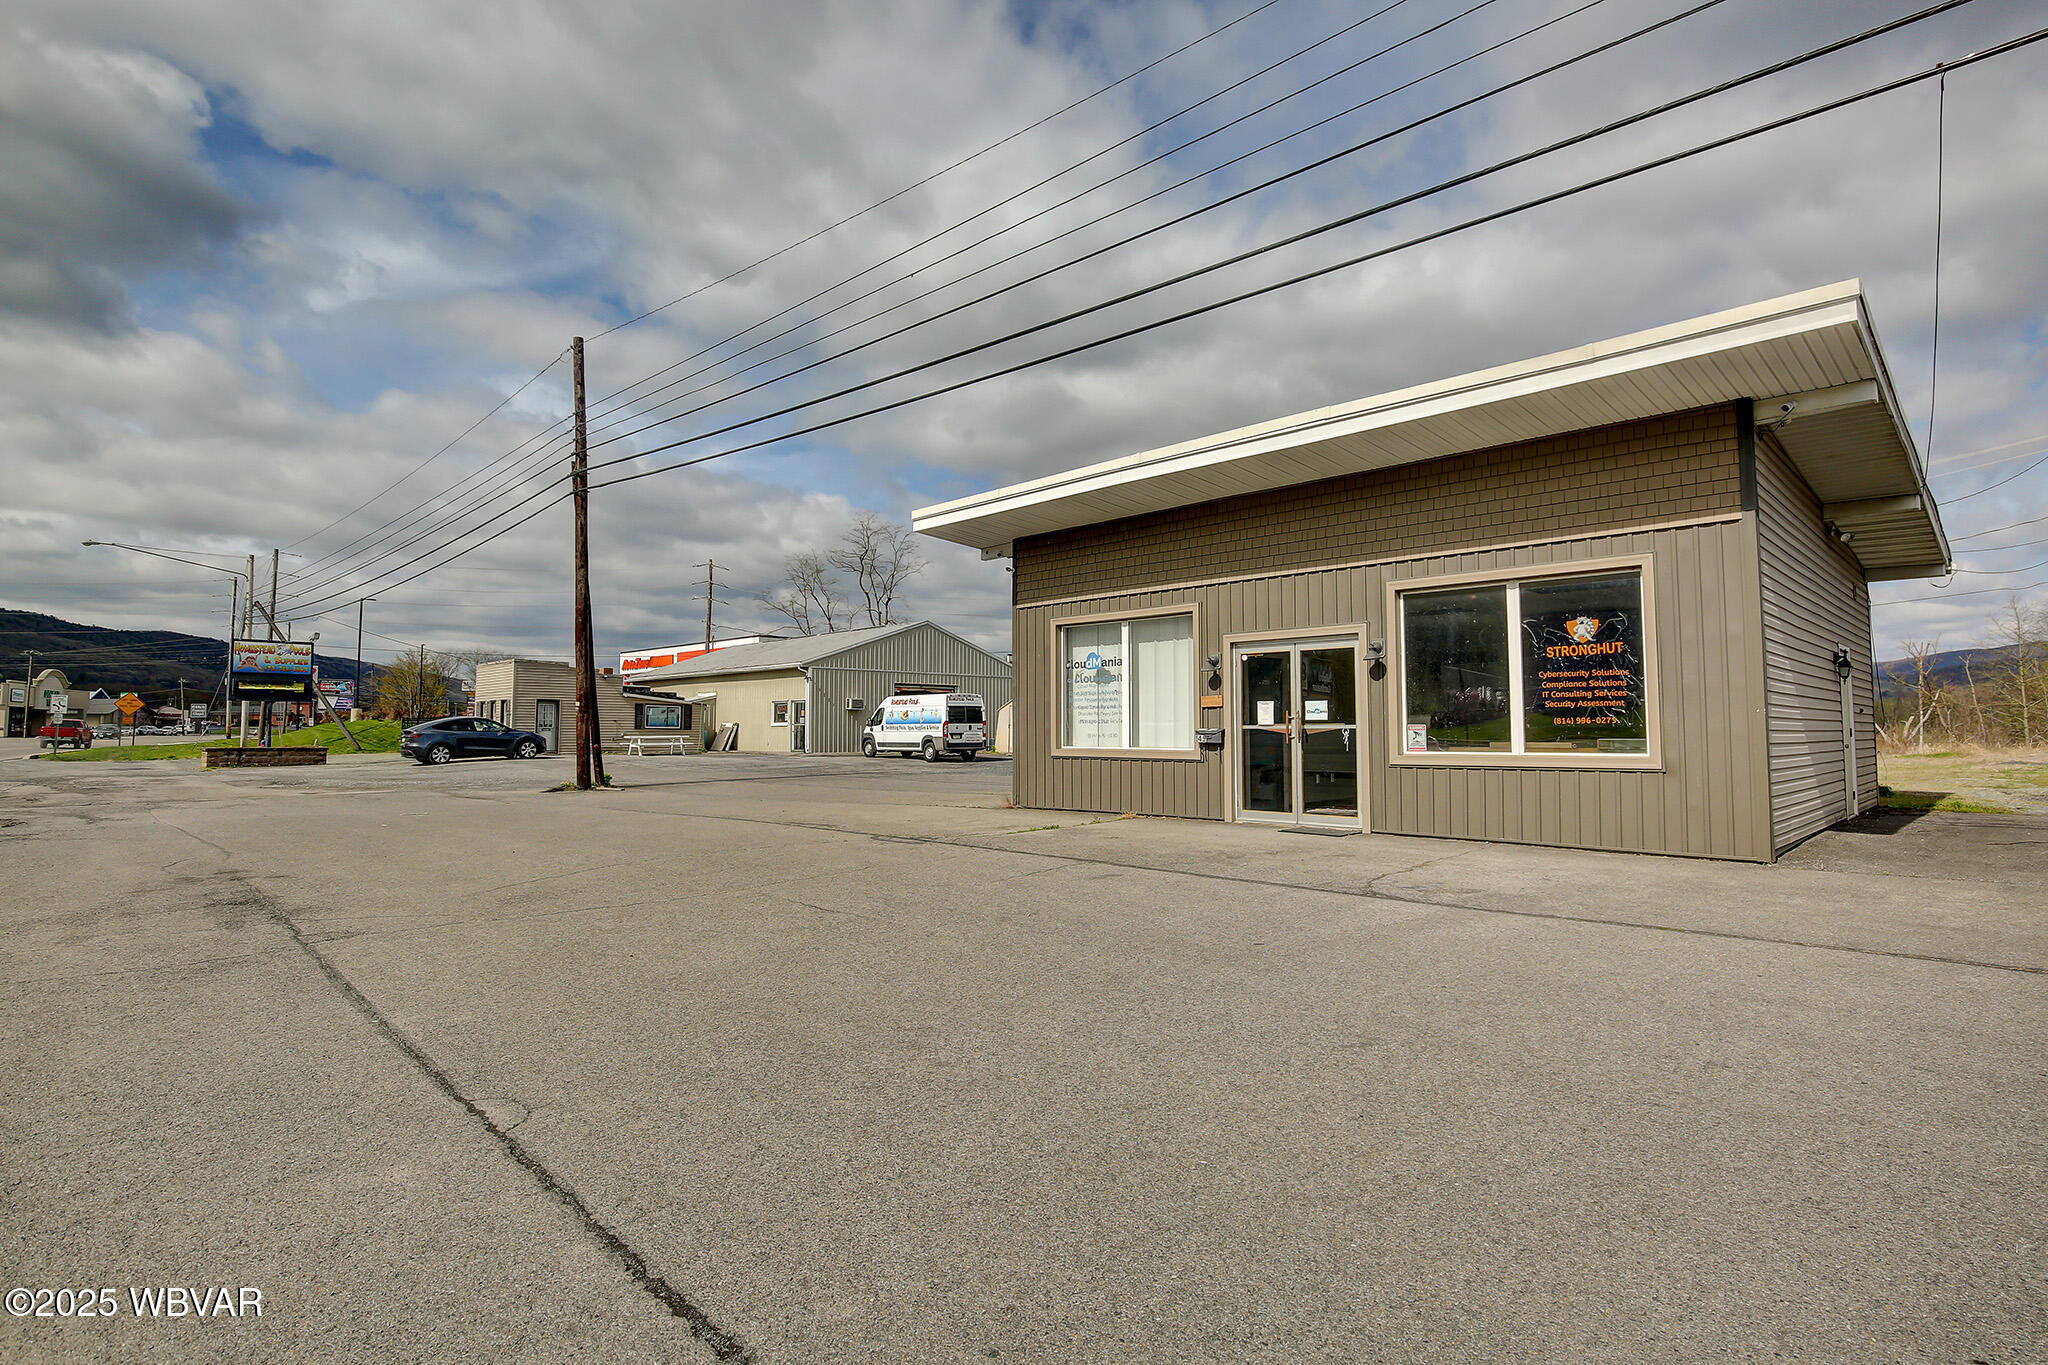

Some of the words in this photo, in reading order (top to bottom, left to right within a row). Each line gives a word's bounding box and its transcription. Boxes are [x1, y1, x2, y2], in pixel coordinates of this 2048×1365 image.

[1546, 642, 1623, 658] STRONGHUT
[1538, 669, 1590, 679] Cybersecurity
[1541, 680, 1587, 688] Compliance
[1550, 690, 1592, 698] Consulting
[1594, 689, 1628, 697] Services
[1553, 717, 1574, 725] (814)
